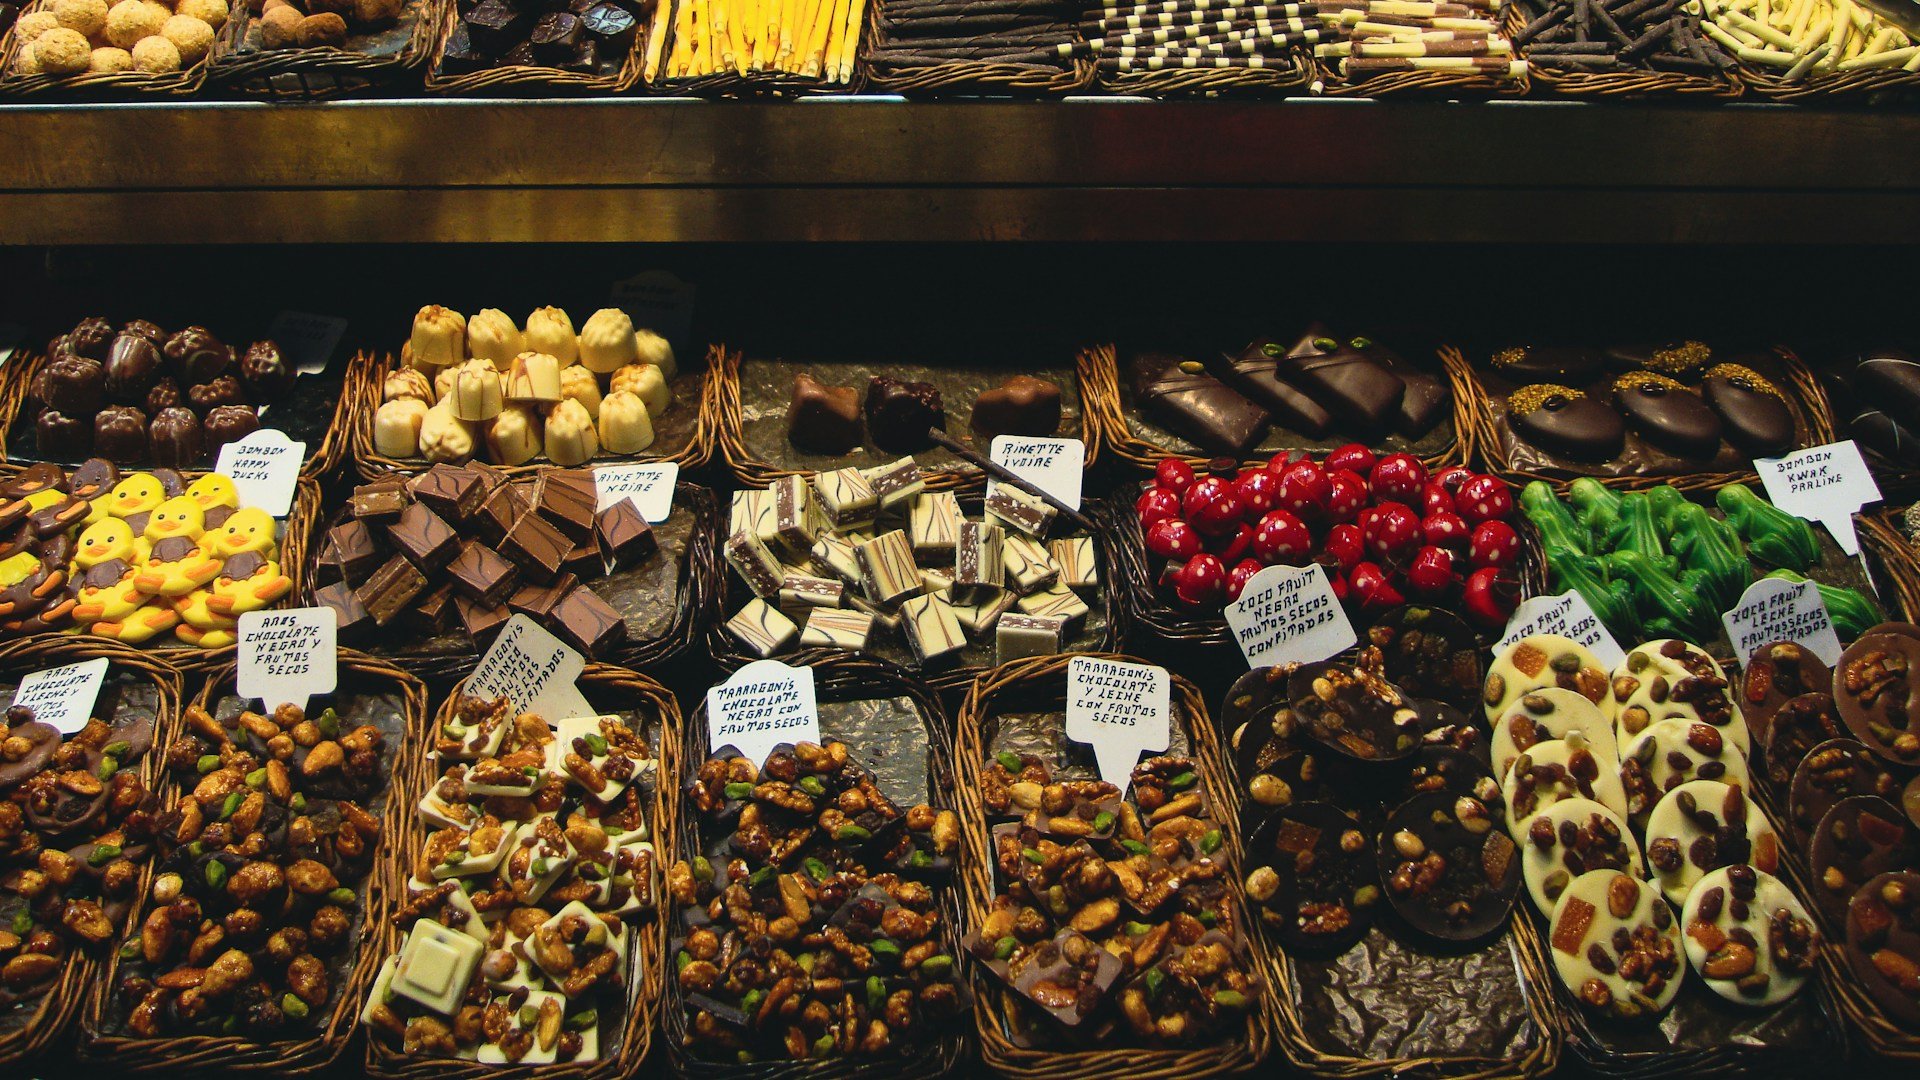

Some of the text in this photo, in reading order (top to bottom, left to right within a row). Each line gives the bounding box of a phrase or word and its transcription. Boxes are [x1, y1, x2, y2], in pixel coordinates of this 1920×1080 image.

[237, 445, 287, 456] BOMBON
[232, 459, 270, 469] HAPPY
[1777, 452, 1832, 473] BOMBON
[232, 471, 269, 480] DUCKS
[1787, 465, 1828, 483] KWAK
[1238, 588, 1273, 613] XOCO
[1254, 592, 1299, 622] NEGRO
[1239, 594, 1329, 643] FRUTOS SECOS
[1732, 600, 1765, 624] XOCO
[1752, 603, 1795, 628] LECHE
[262, 616, 296, 628] AROS
[1741, 608, 1823, 649] FRUTOS SECOS
[245, 626, 320, 642] CHOCOLATE
[256, 638, 321, 653] NEGRO Y
[255, 652, 309, 664] FRUTOS
[42, 666, 80, 680] AROS
[268, 664, 310, 675] SECOS
[487, 646, 522, 695] BLANCO
[25, 673, 93, 693] CHOCOLATE
[510, 661, 540, 705] SECOS
[1078, 674, 1157, 694] CHOCOLATE
[20, 688, 80, 704] Y LECHE Y
[722, 690, 799, 712] CHOCOLATE
[1085, 686, 1142, 703] Y LECHE
[35, 709, 68, 720] ECOS
[727, 702, 802, 721] NEGRO CON
[1076, 699, 1156, 718] CON FRUTOS
[718, 715, 810, 736] FRUTOS SECOS
[1092, 712, 1138, 726] SECOS
